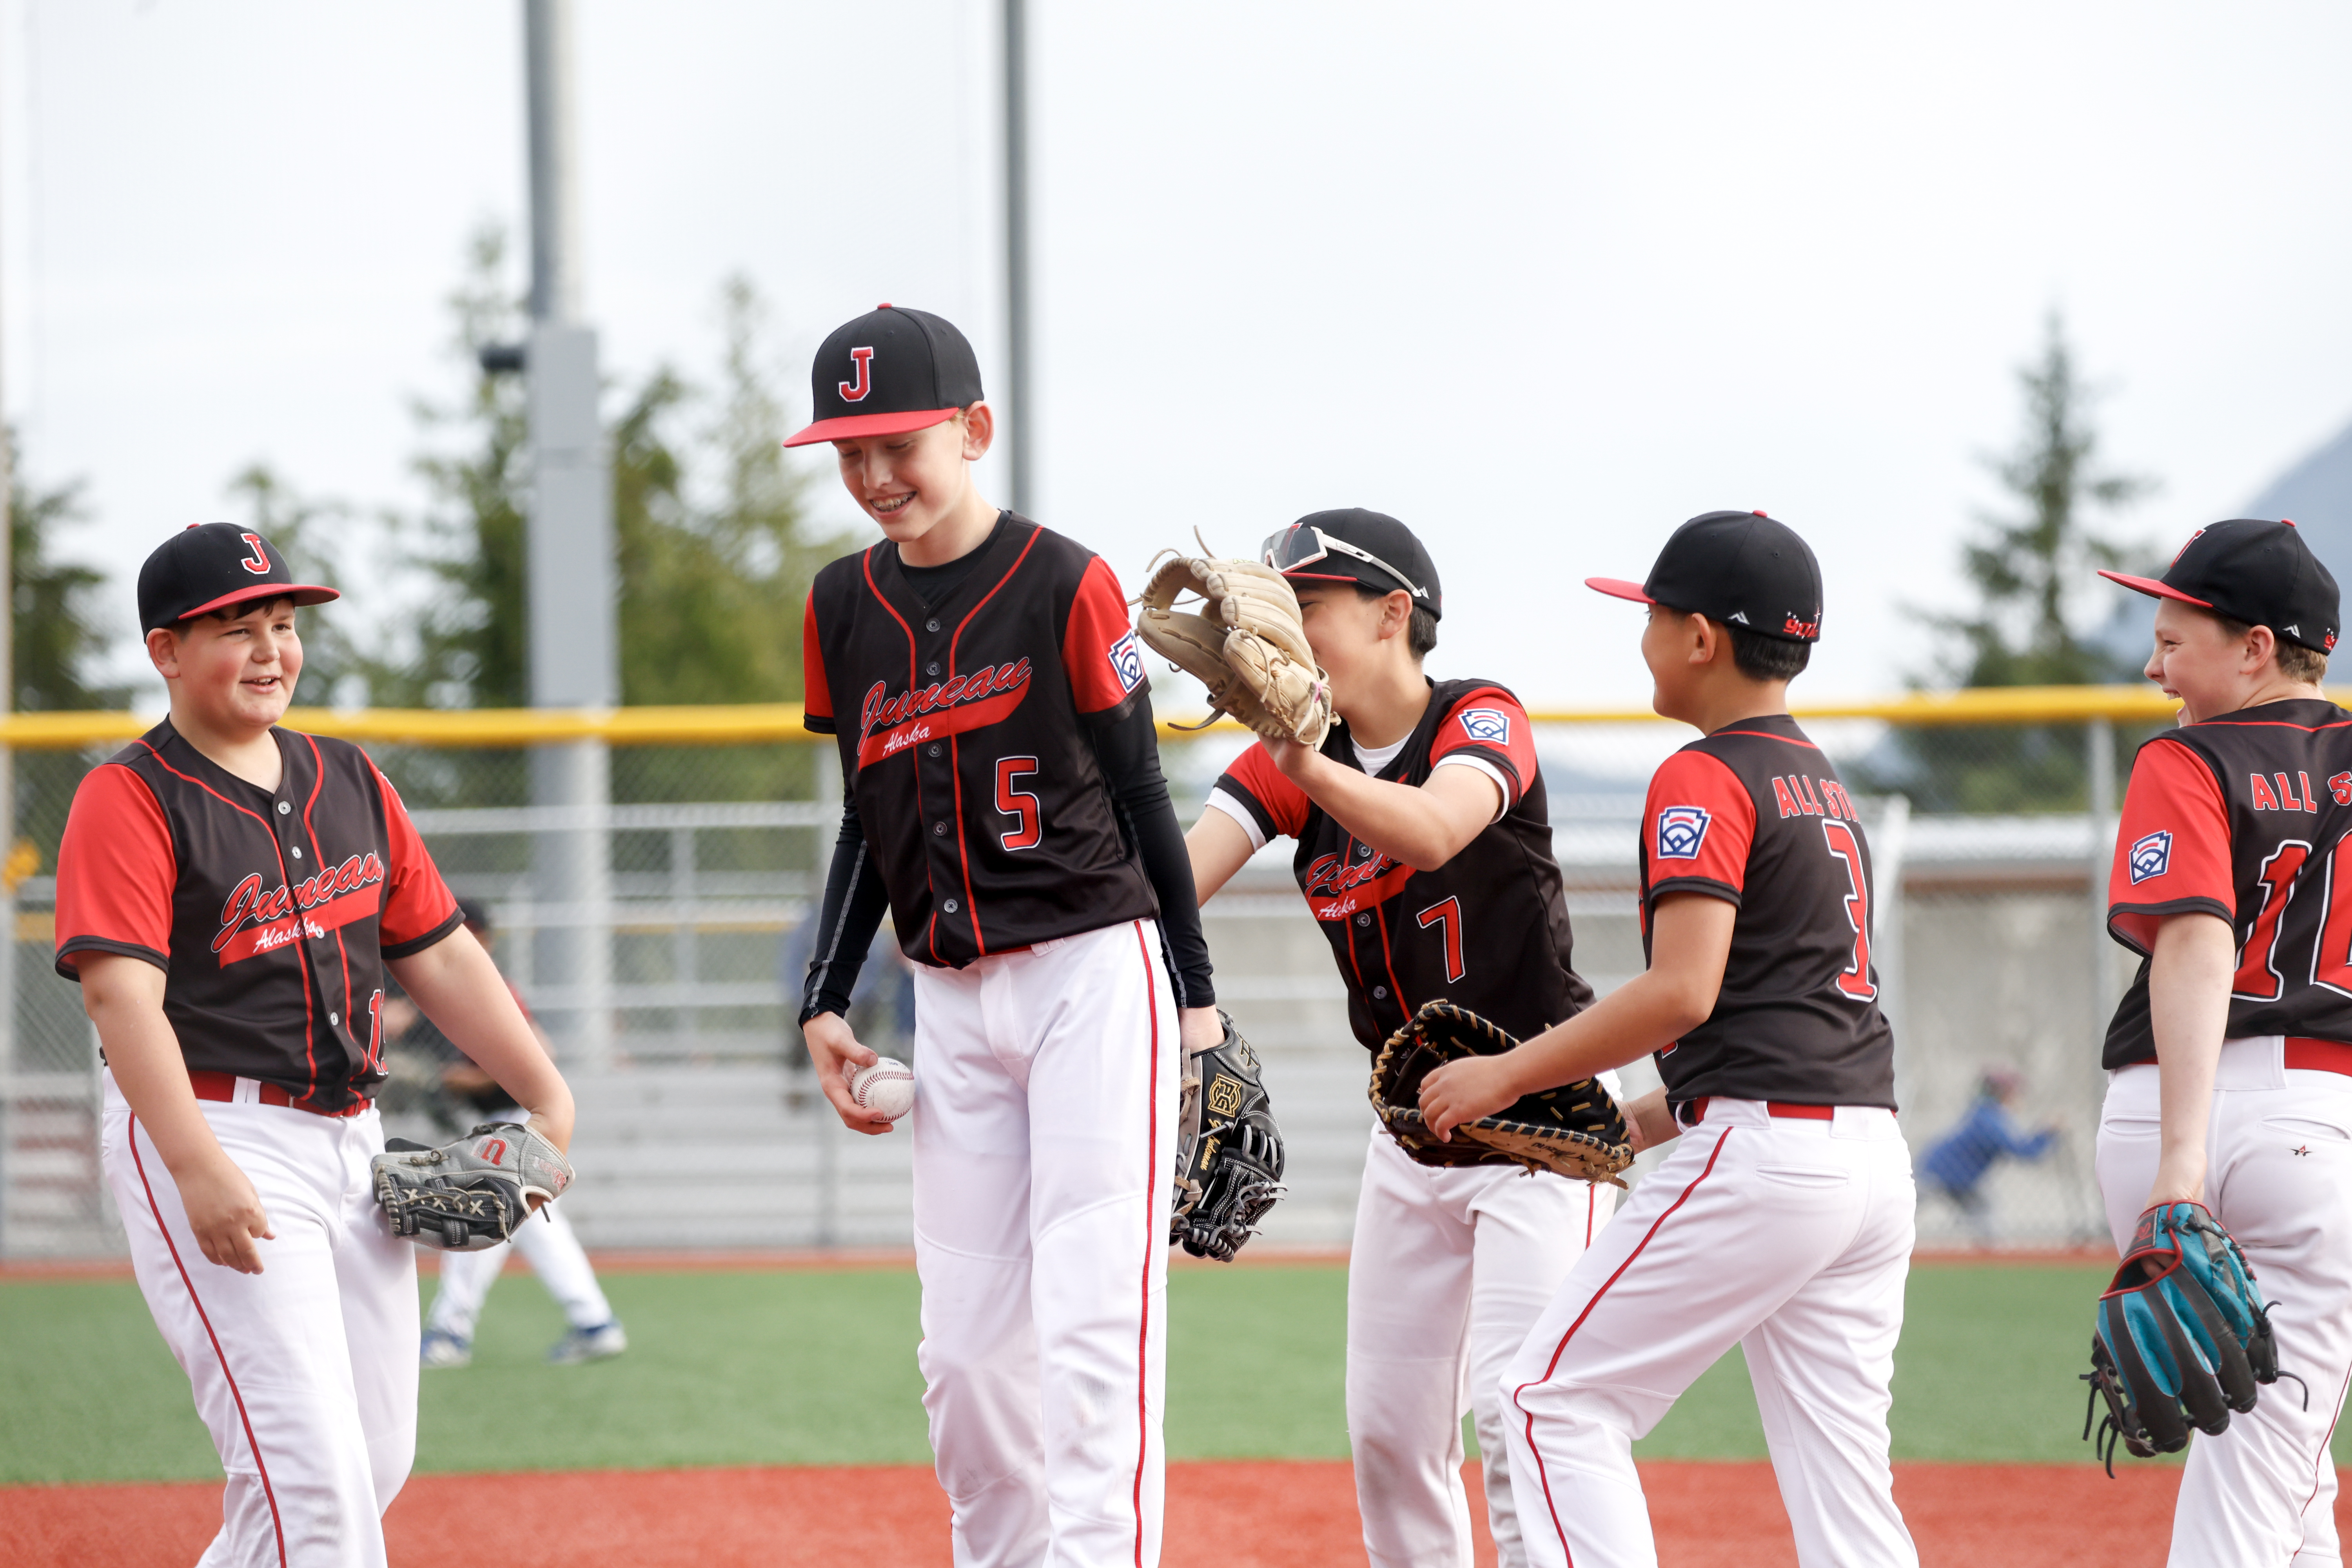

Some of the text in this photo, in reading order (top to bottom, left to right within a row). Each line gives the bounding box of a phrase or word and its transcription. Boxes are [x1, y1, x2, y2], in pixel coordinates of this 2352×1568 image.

[838, 346, 874, 402] J
[240, 533, 271, 575] J
[858, 657, 1032, 756] Juneau
[882, 722, 931, 757] Alaska
[995, 755, 1042, 851] 5
[1772, 774, 1825, 818] ALL
[2250, 770, 2352, 814] ALL S
[211, 850, 384, 953] Juneau
[1822, 818, 1877, 1003] 3
[1416, 895, 1466, 984] 7
